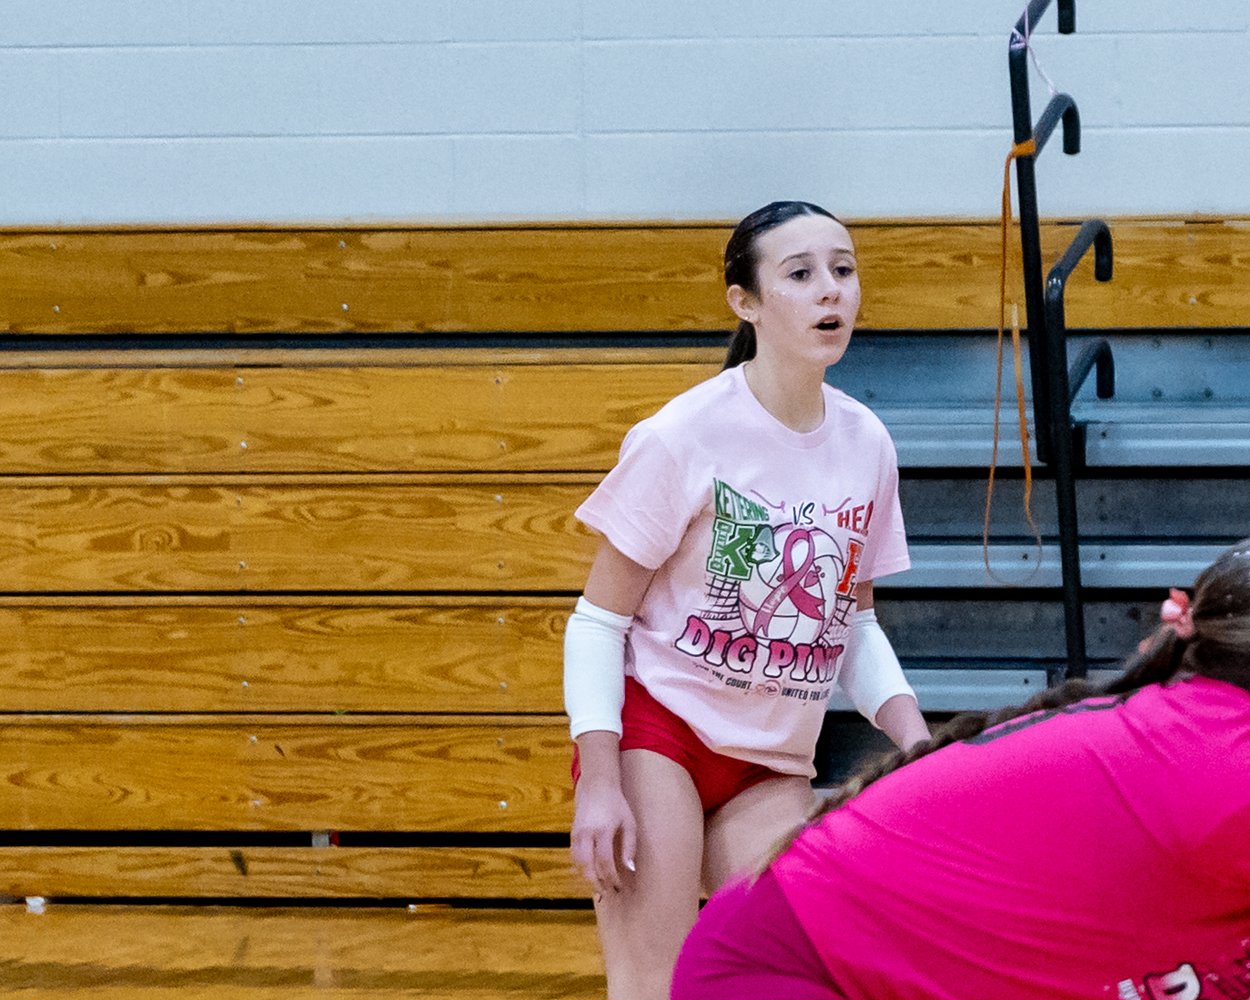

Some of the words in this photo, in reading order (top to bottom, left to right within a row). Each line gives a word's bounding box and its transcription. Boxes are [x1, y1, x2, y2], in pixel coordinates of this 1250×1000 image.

[792, 501, 815, 525] VS
[675, 615, 757, 673] DIG
[725, 676, 752, 690] COURT
[781, 687, 808, 700] UNITED
